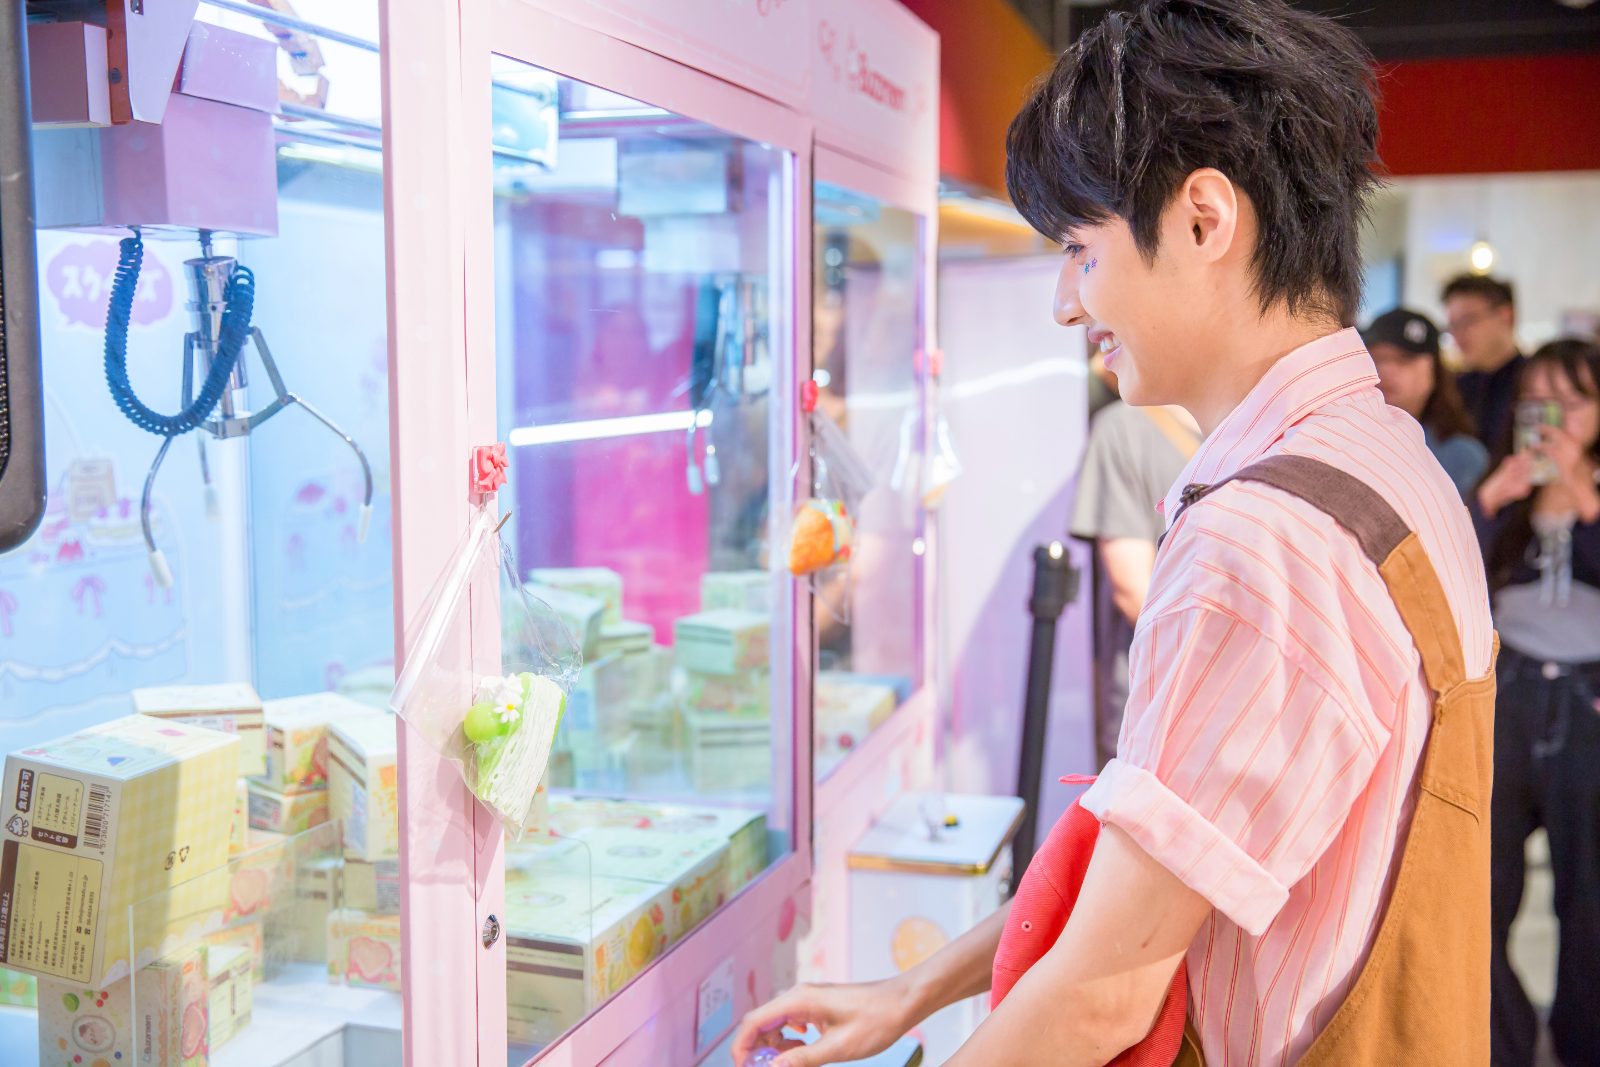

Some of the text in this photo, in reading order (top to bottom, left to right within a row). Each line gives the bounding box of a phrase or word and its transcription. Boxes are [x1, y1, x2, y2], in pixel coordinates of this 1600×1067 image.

[18, 770, 31, 810] 食用不可
[38, 831, 69, 844] セット内容
